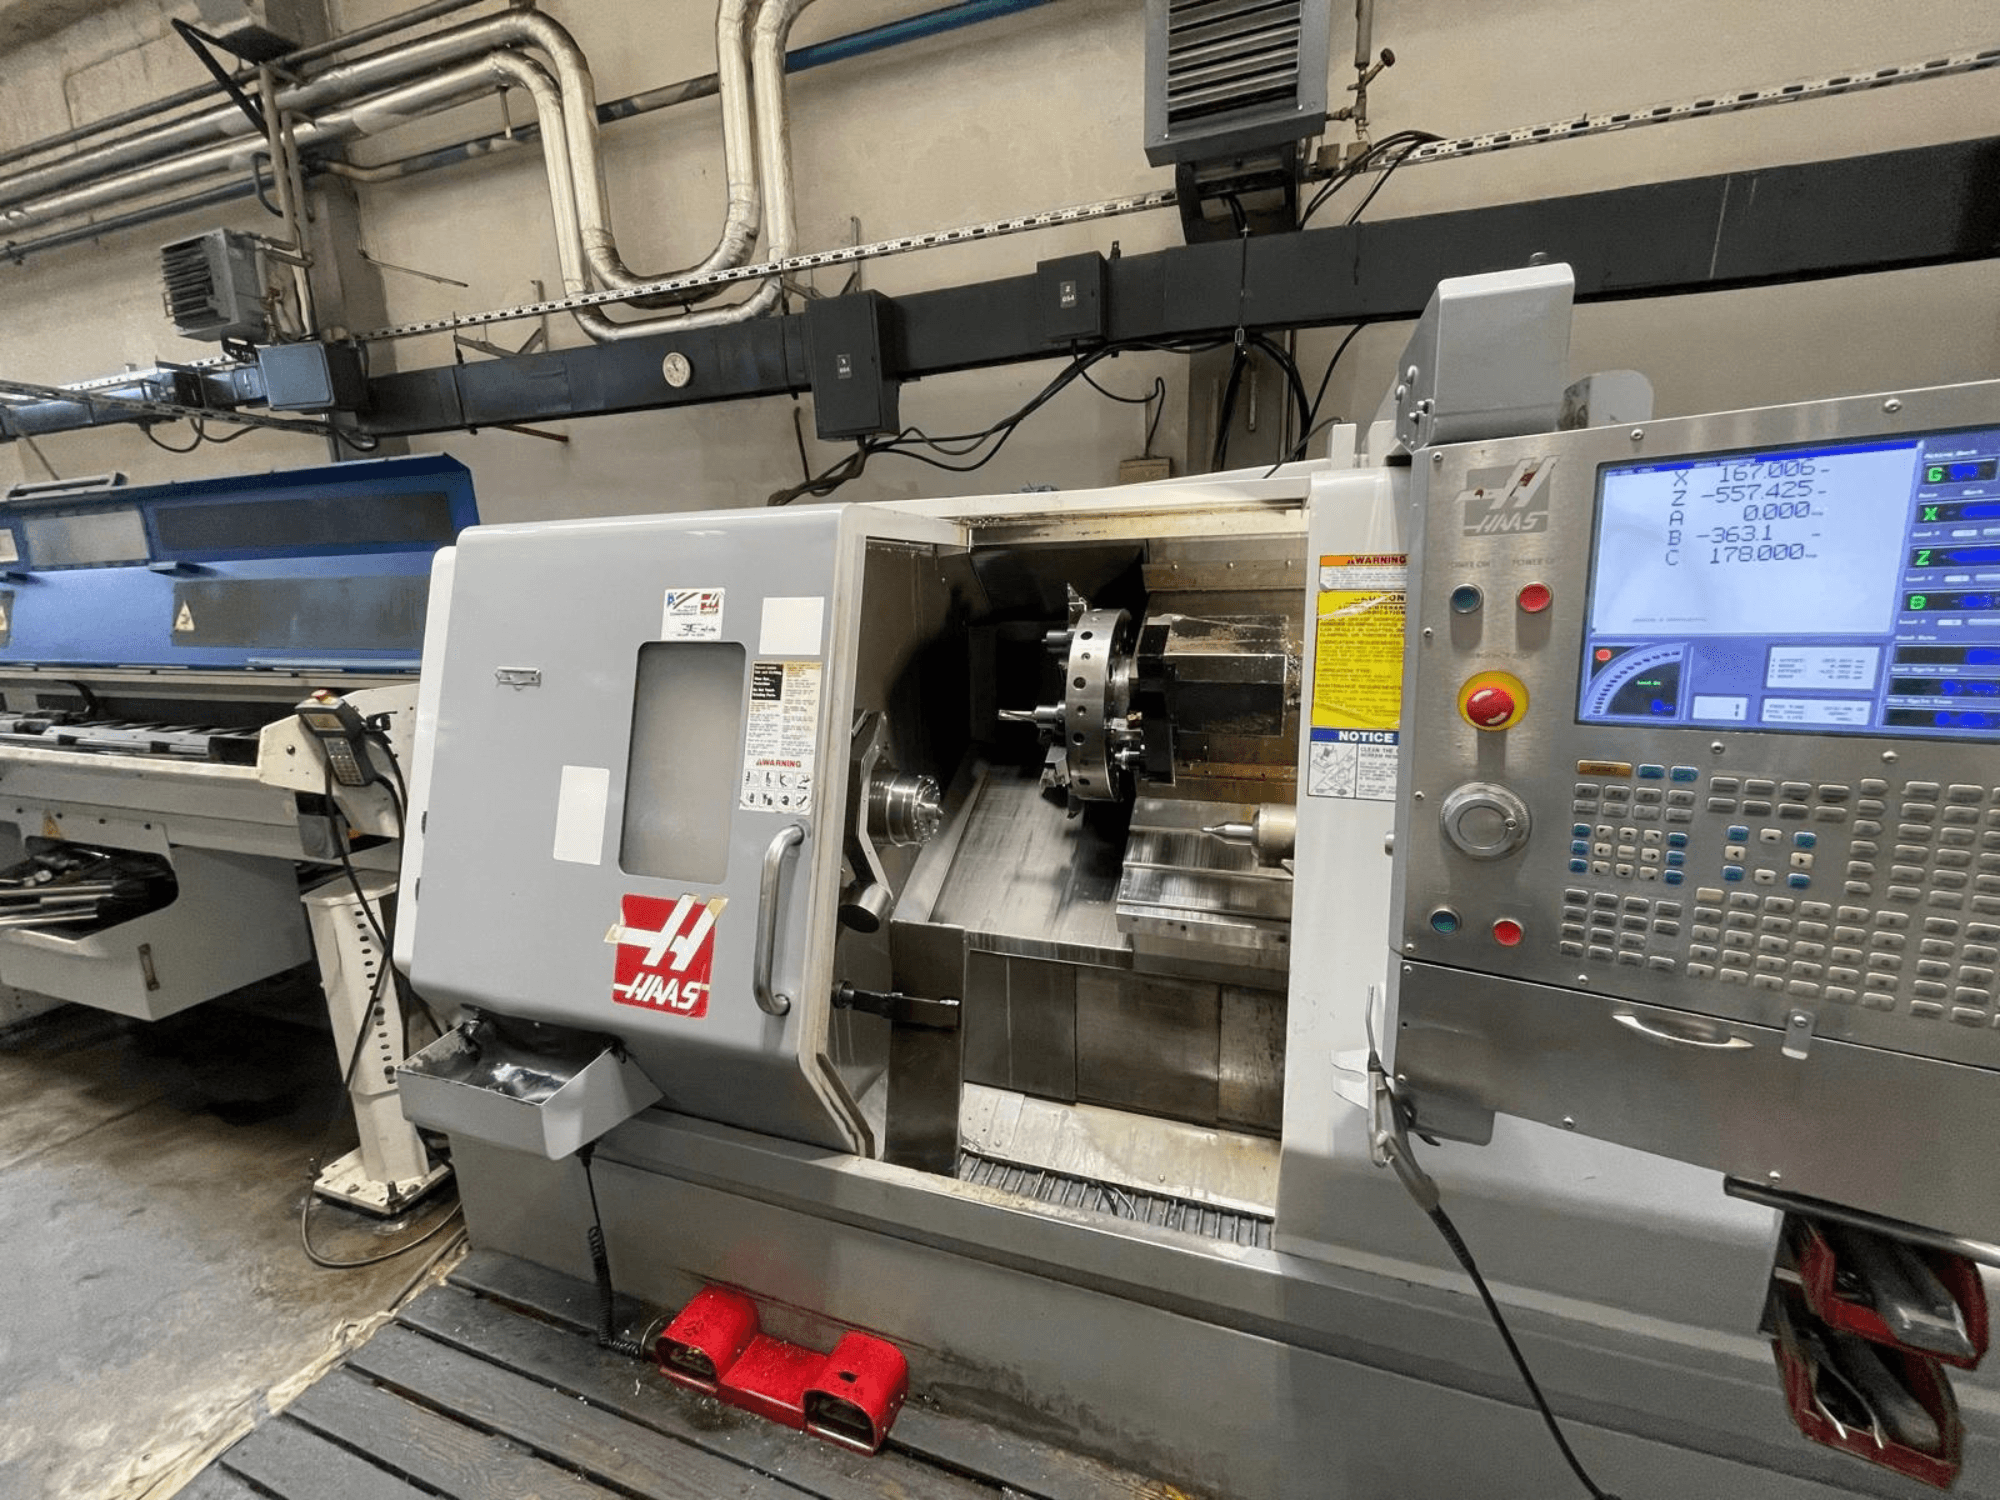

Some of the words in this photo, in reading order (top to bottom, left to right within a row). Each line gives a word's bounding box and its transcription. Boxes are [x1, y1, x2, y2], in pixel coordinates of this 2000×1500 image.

[1674, 469, 1689, 487] X
[1719, 458, 1816, 483] 167.006
[1928, 467, 1944, 482] G
[1671, 490, 1687, 506] Z
[1701, 479, 1814, 503] -557.425
[1463, 510, 1548, 533] HAAS
[1669, 510, 1684, 526] A
[1743, 501, 1811, 521] 0.000
[1923, 506, 1938, 521] X
[1667, 529, 1682, 546] B
[1696, 524, 1772, 544] -363.1
[1355, 555, 1407, 564] WARNING
[1665, 549, 1680, 566] C
[1710, 543, 1805, 564] 178.000
[1915, 549, 1931, 566] Z
[1338, 730, 1395, 743] NOTICE
[761, 759, 802, 768] WARNING
[613, 972, 710, 1010] HAAS
